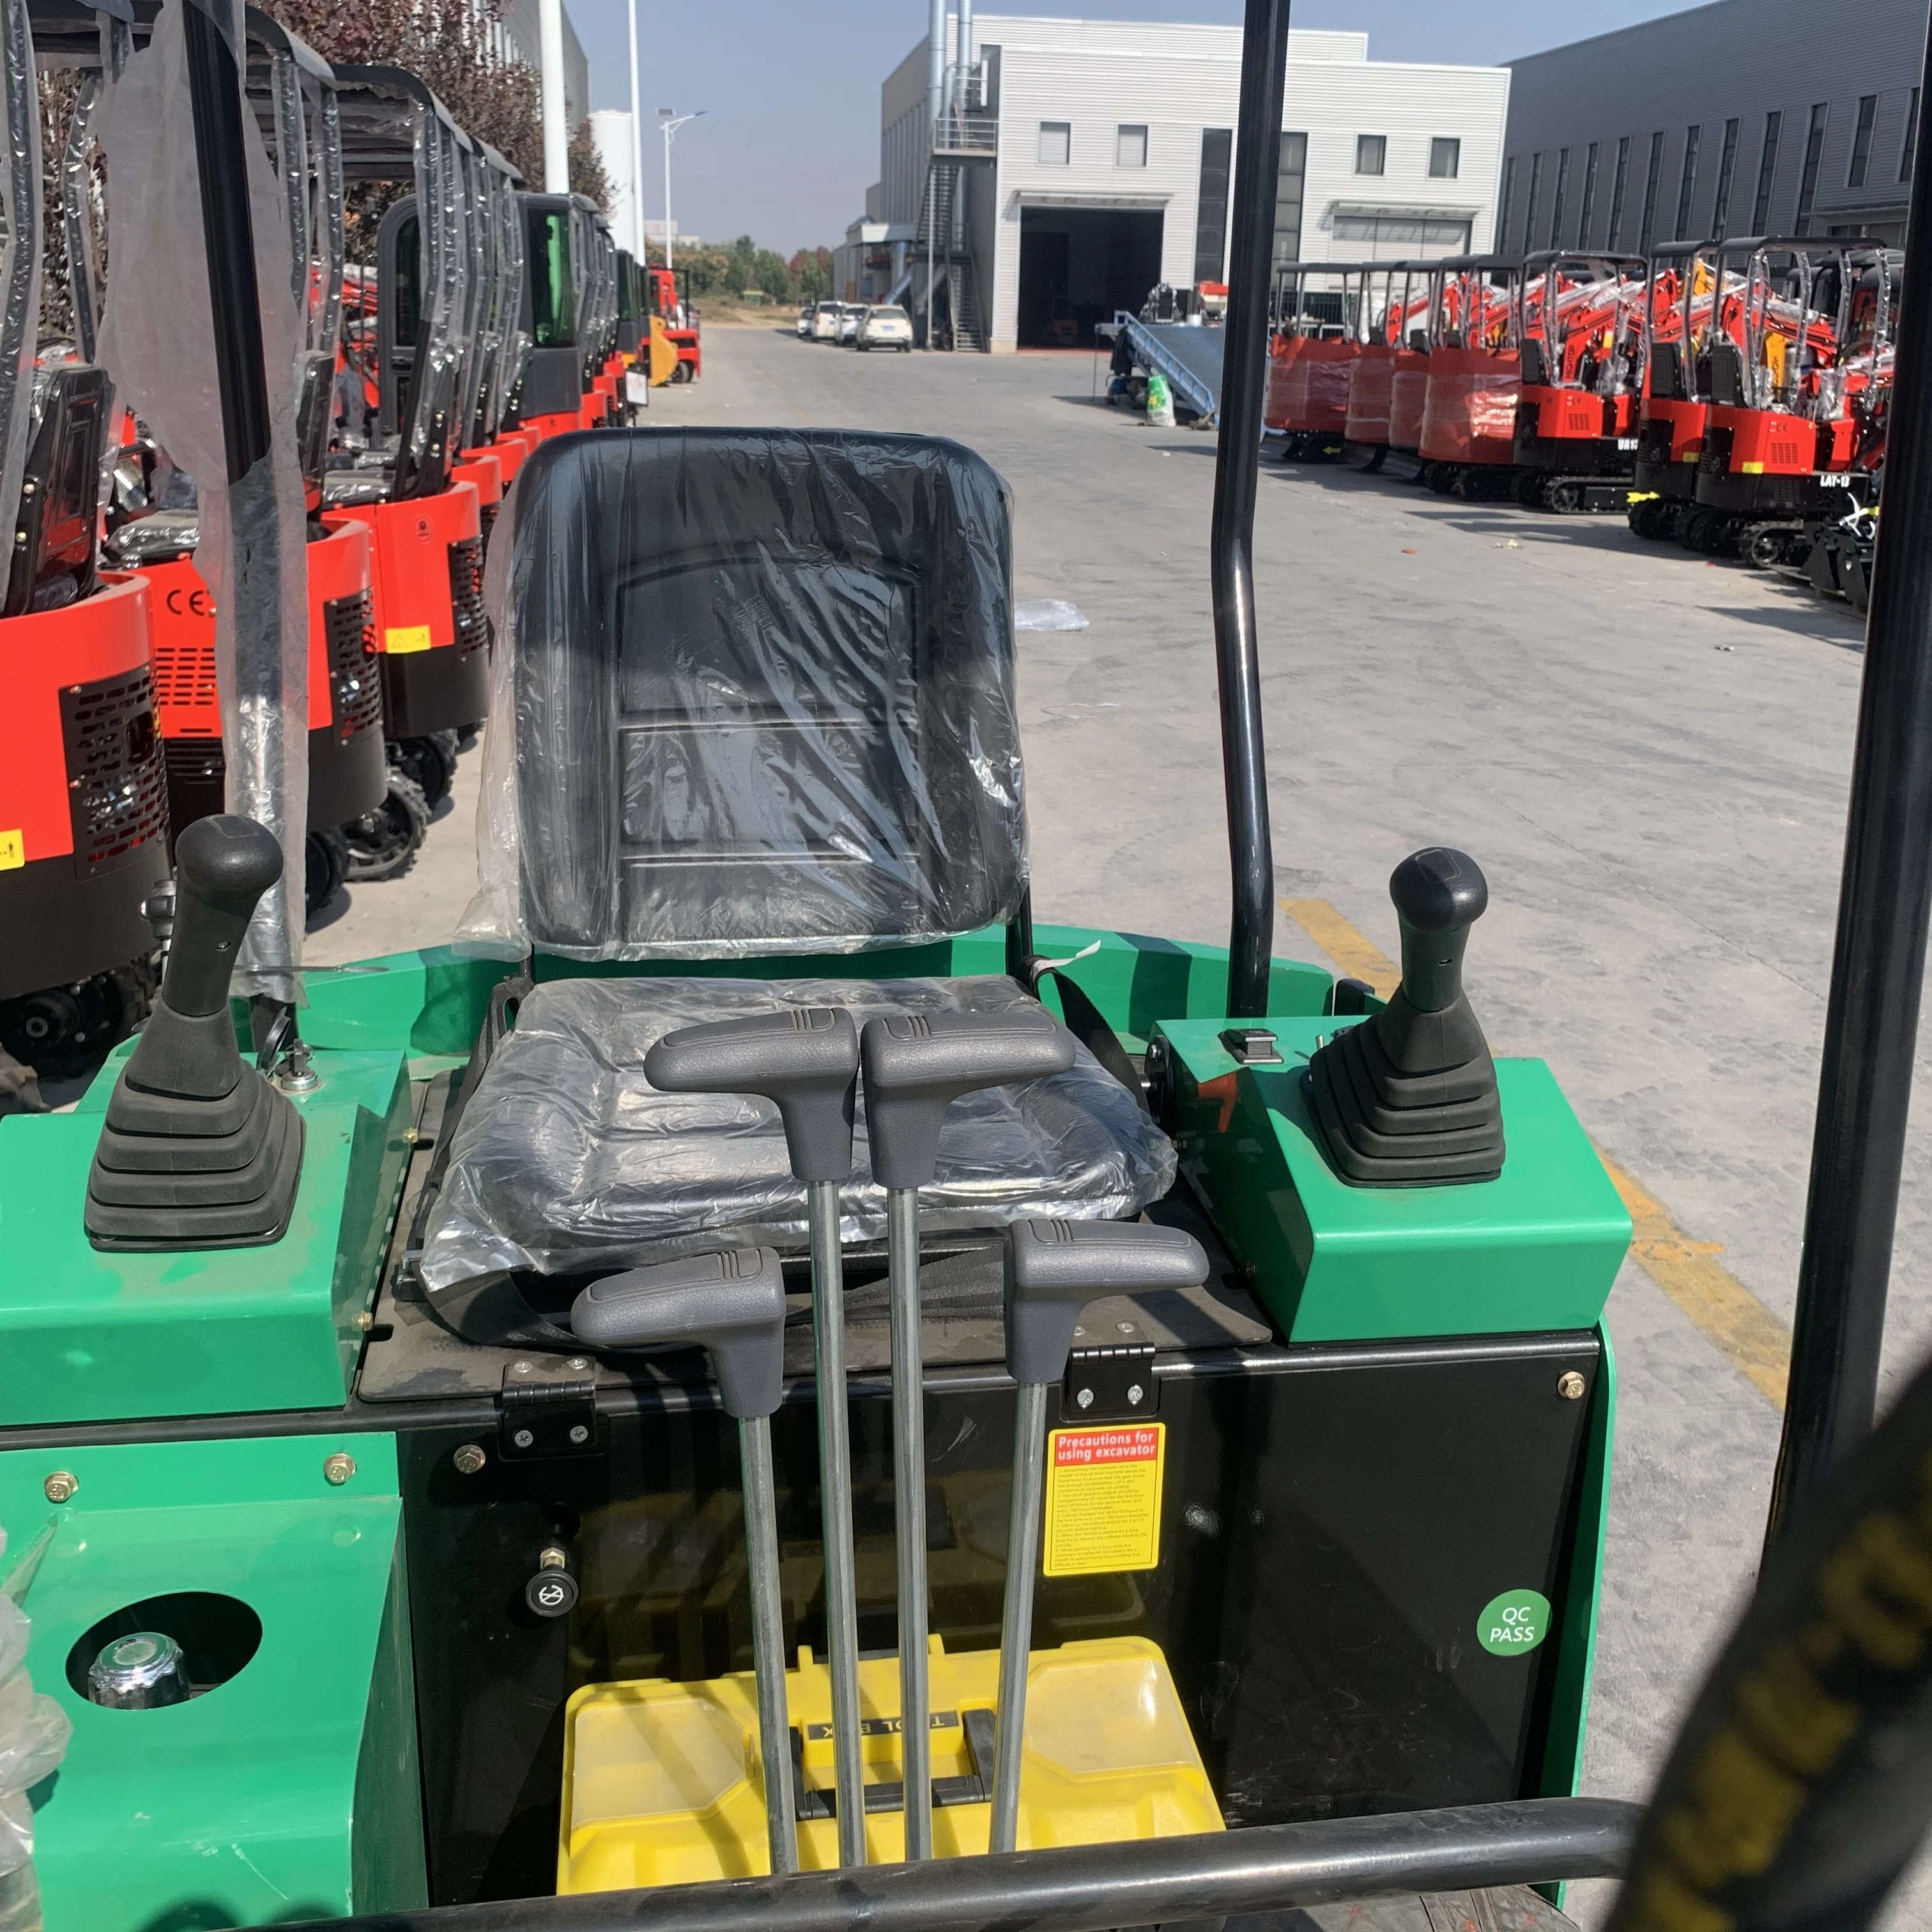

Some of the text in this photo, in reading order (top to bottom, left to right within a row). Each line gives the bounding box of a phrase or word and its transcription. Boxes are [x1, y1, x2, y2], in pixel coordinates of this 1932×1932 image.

[167, 589, 205, 616] CE
[1059, 1431, 1154, 1448] Precautions for
[1058, 1445, 1156, 1462] using excavator
[1502, 1606, 1531, 1625] QC
[1489, 1627, 1535, 1643] PASS
[822, 1715, 946, 1737] TL BX
